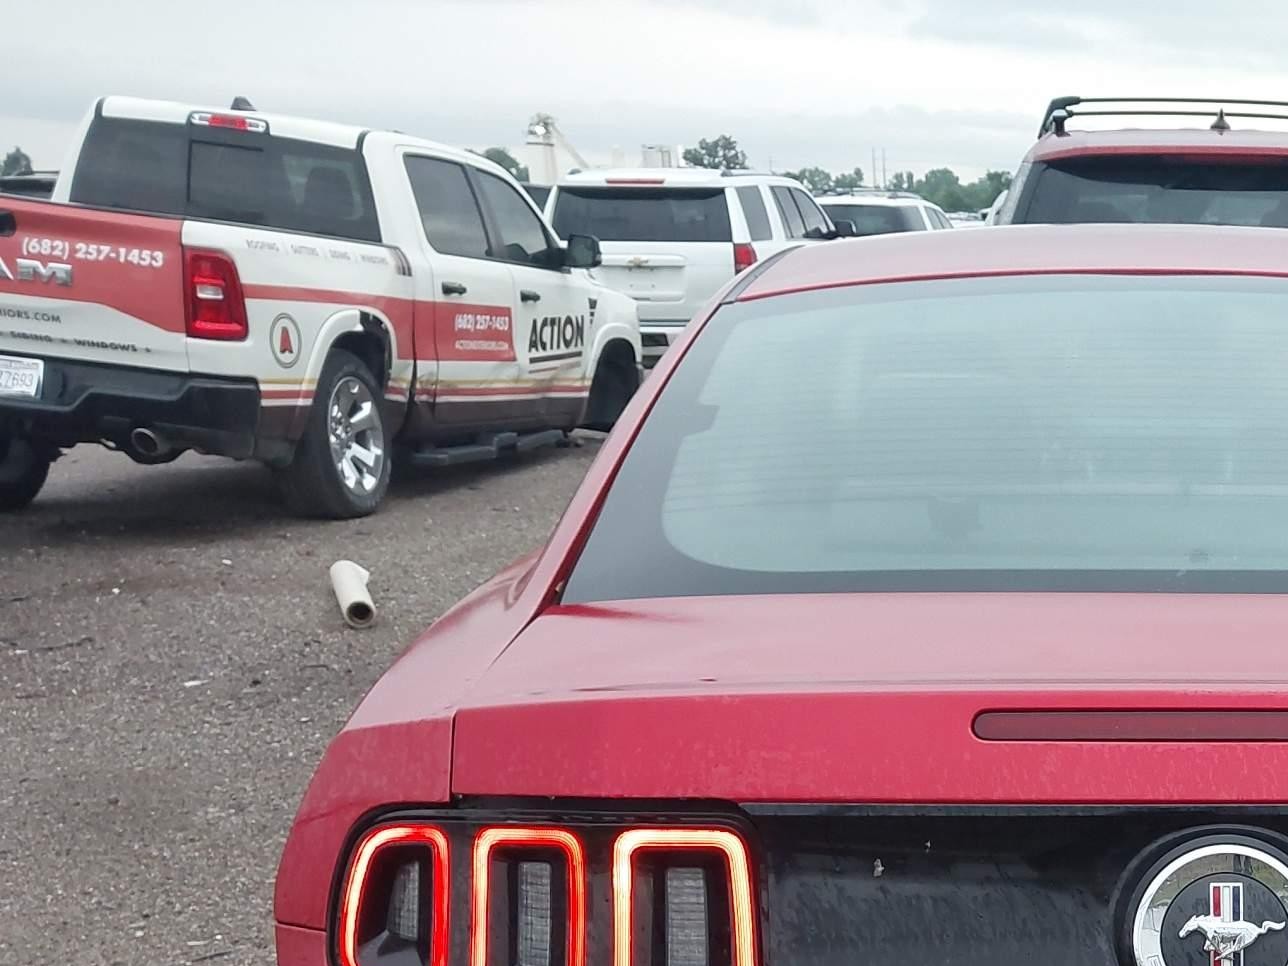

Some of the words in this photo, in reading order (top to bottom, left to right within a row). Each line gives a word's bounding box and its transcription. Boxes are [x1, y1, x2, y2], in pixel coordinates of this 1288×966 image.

[22, 237, 69, 260] (682)
[75, 242, 164, 267] 257-1453
[0, 309, 61, 323] IORS.COM
[10, 331, 53, 343] SIDING
[74, 338, 138, 352] WINDOWS
[528, 315, 584, 353] ACTION
